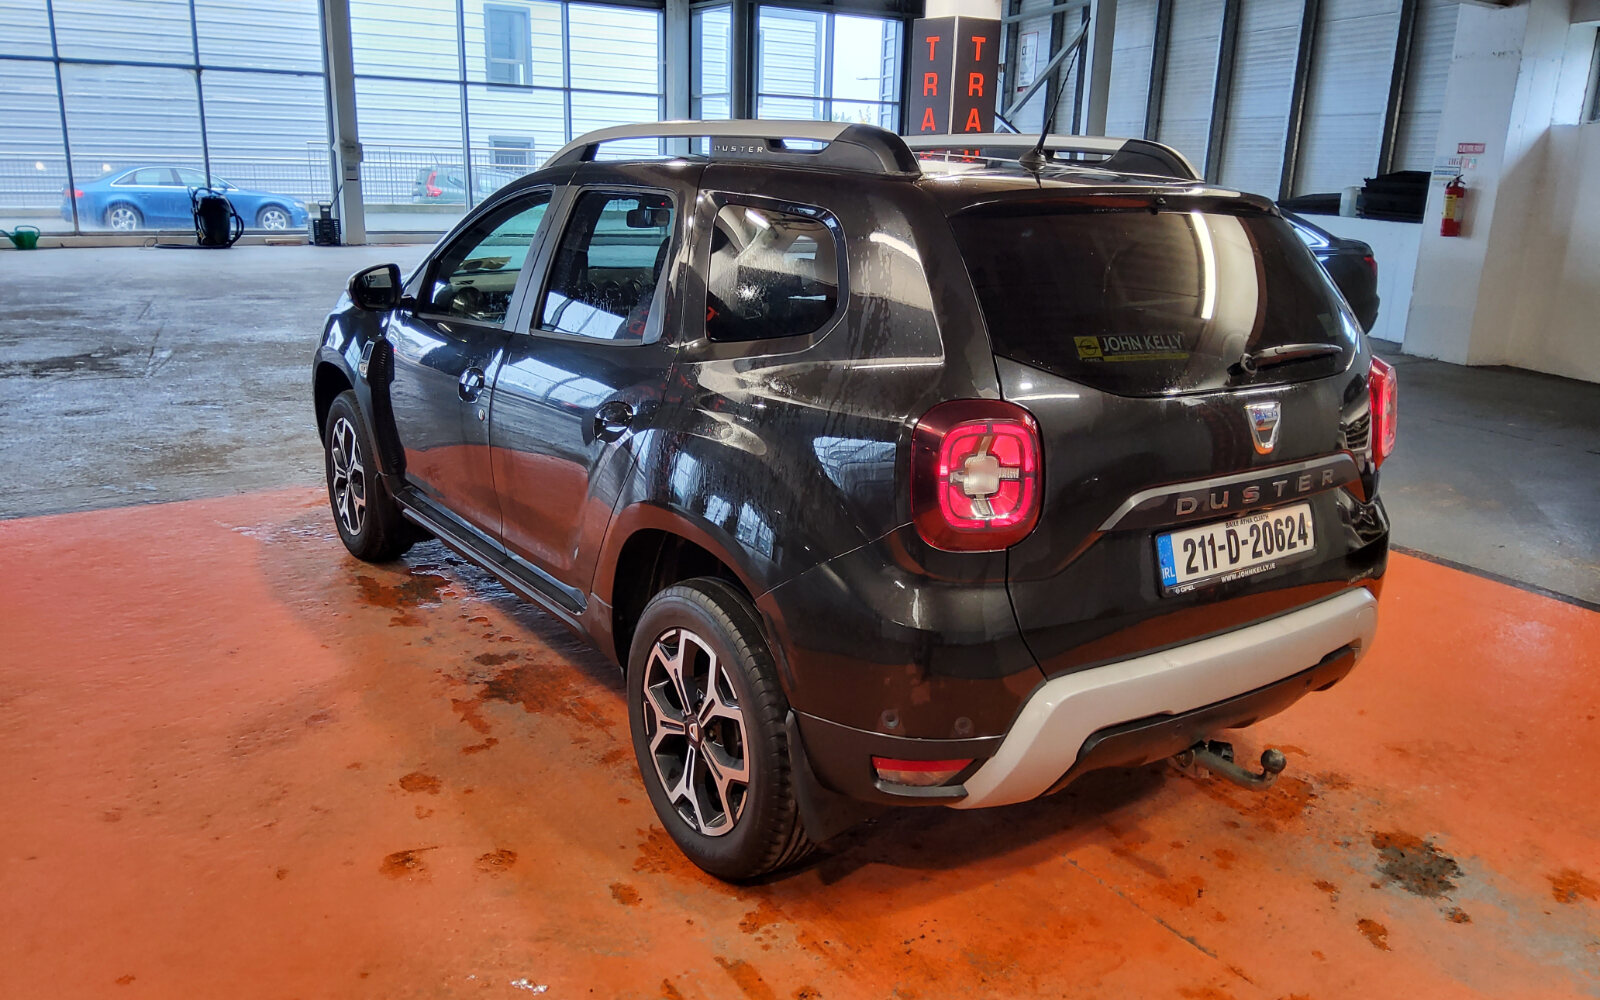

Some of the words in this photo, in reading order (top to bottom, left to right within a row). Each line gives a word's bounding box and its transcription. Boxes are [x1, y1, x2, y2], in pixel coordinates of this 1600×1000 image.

[1101, 335, 1143, 352] JOHN
[1143, 335, 1183, 350] KELLY
[1176, 469, 1334, 516] DUSTER
[1183, 512, 1308, 575] 211-D-20624
[1161, 566, 1176, 580] IRL
